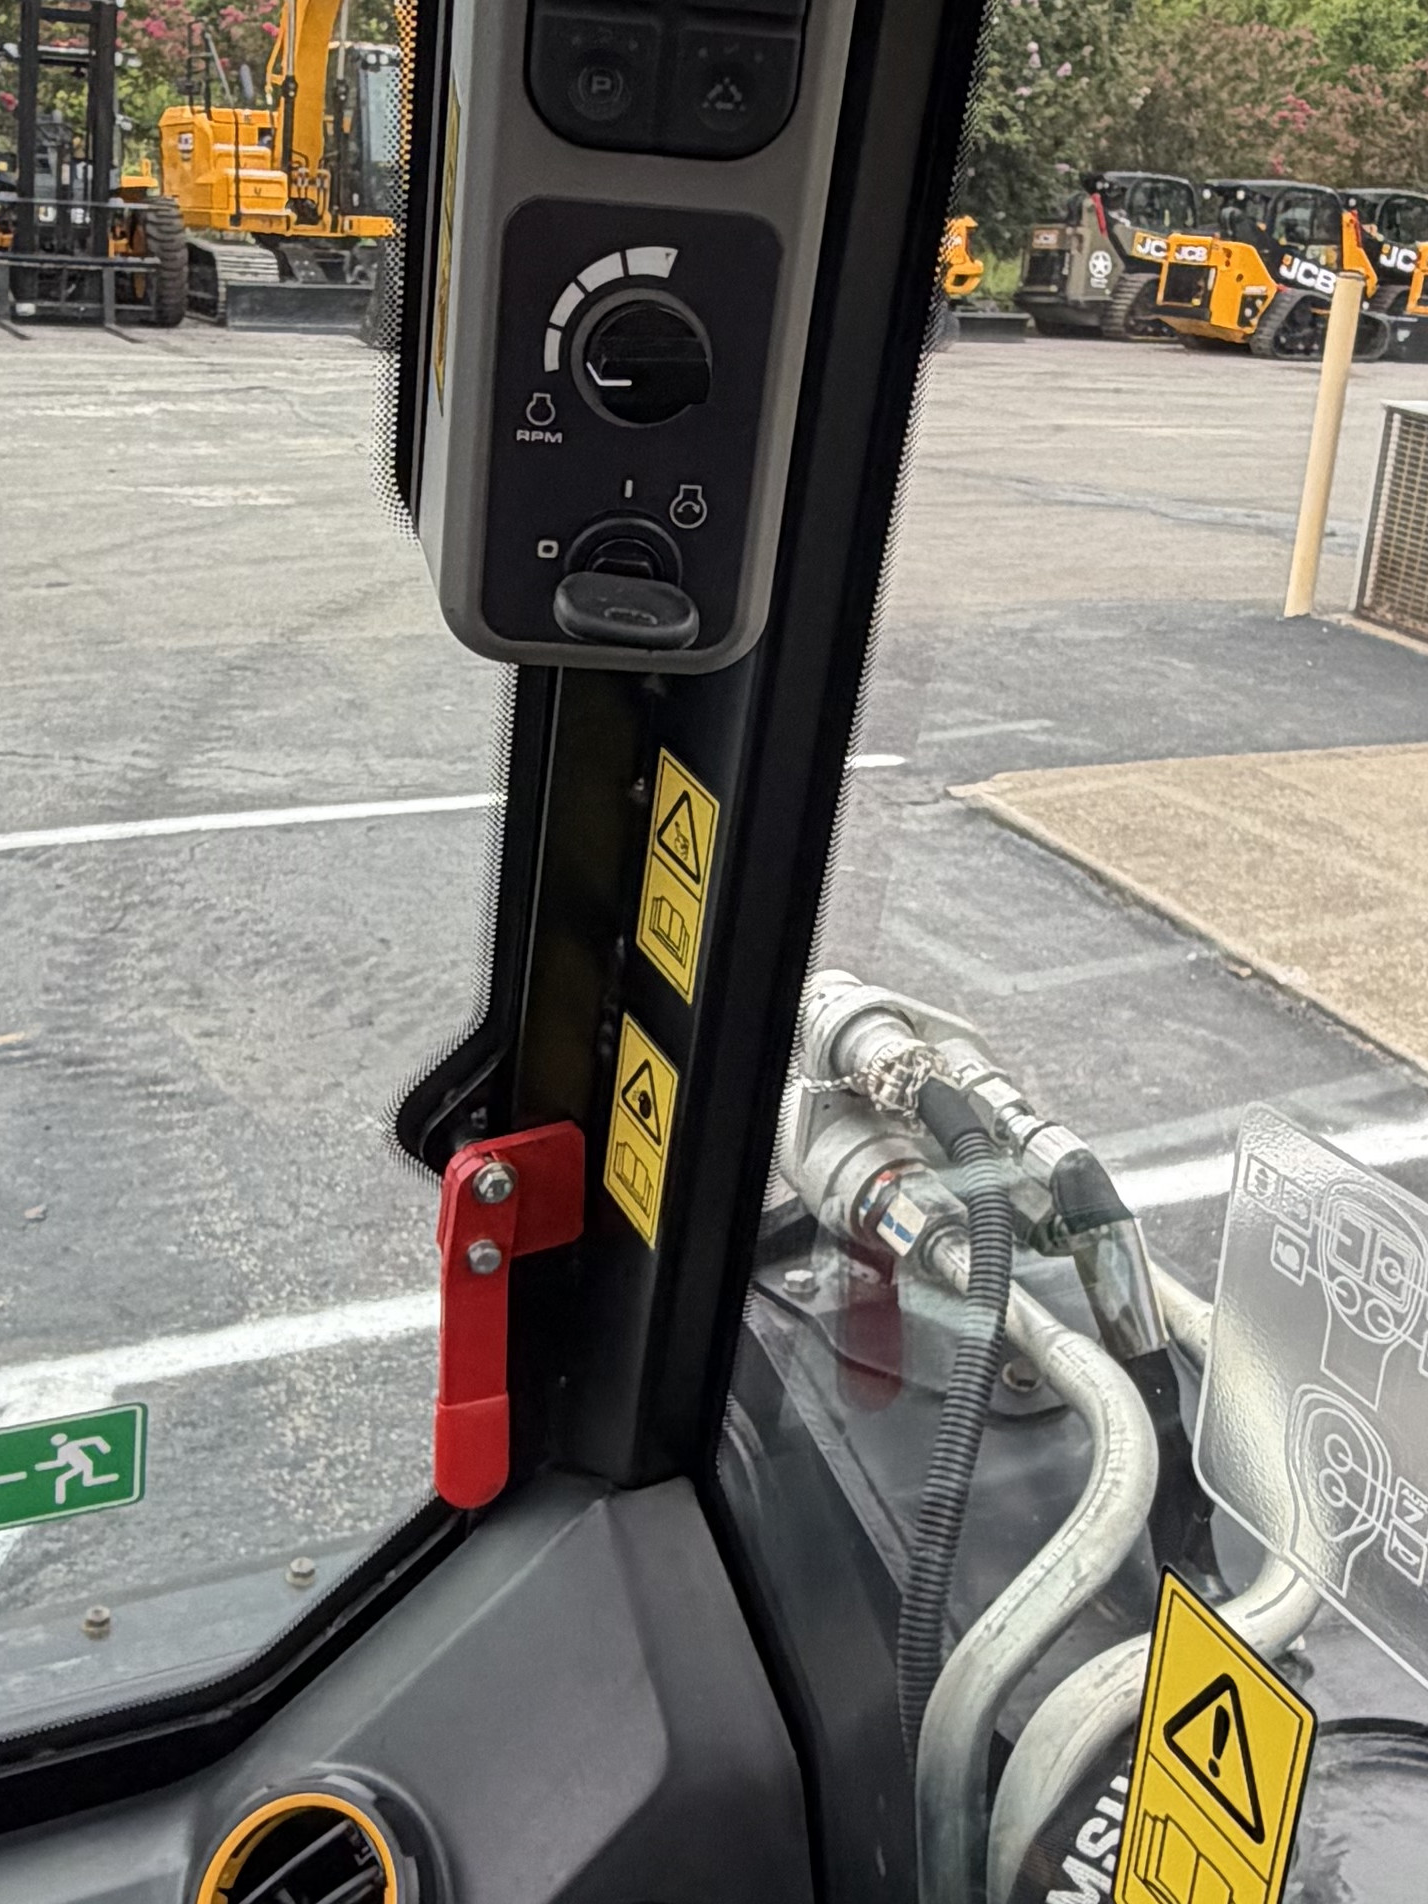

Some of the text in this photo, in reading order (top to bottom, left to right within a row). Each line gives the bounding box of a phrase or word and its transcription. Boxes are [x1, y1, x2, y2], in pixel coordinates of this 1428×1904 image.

[1136, 239, 1169, 258] JC
[1175, 245, 1208, 262] JCB
[1379, 246, 1417, 273] JC
[1279, 256, 1336, 294] JCB
[516, 429, 563, 444] RPM
